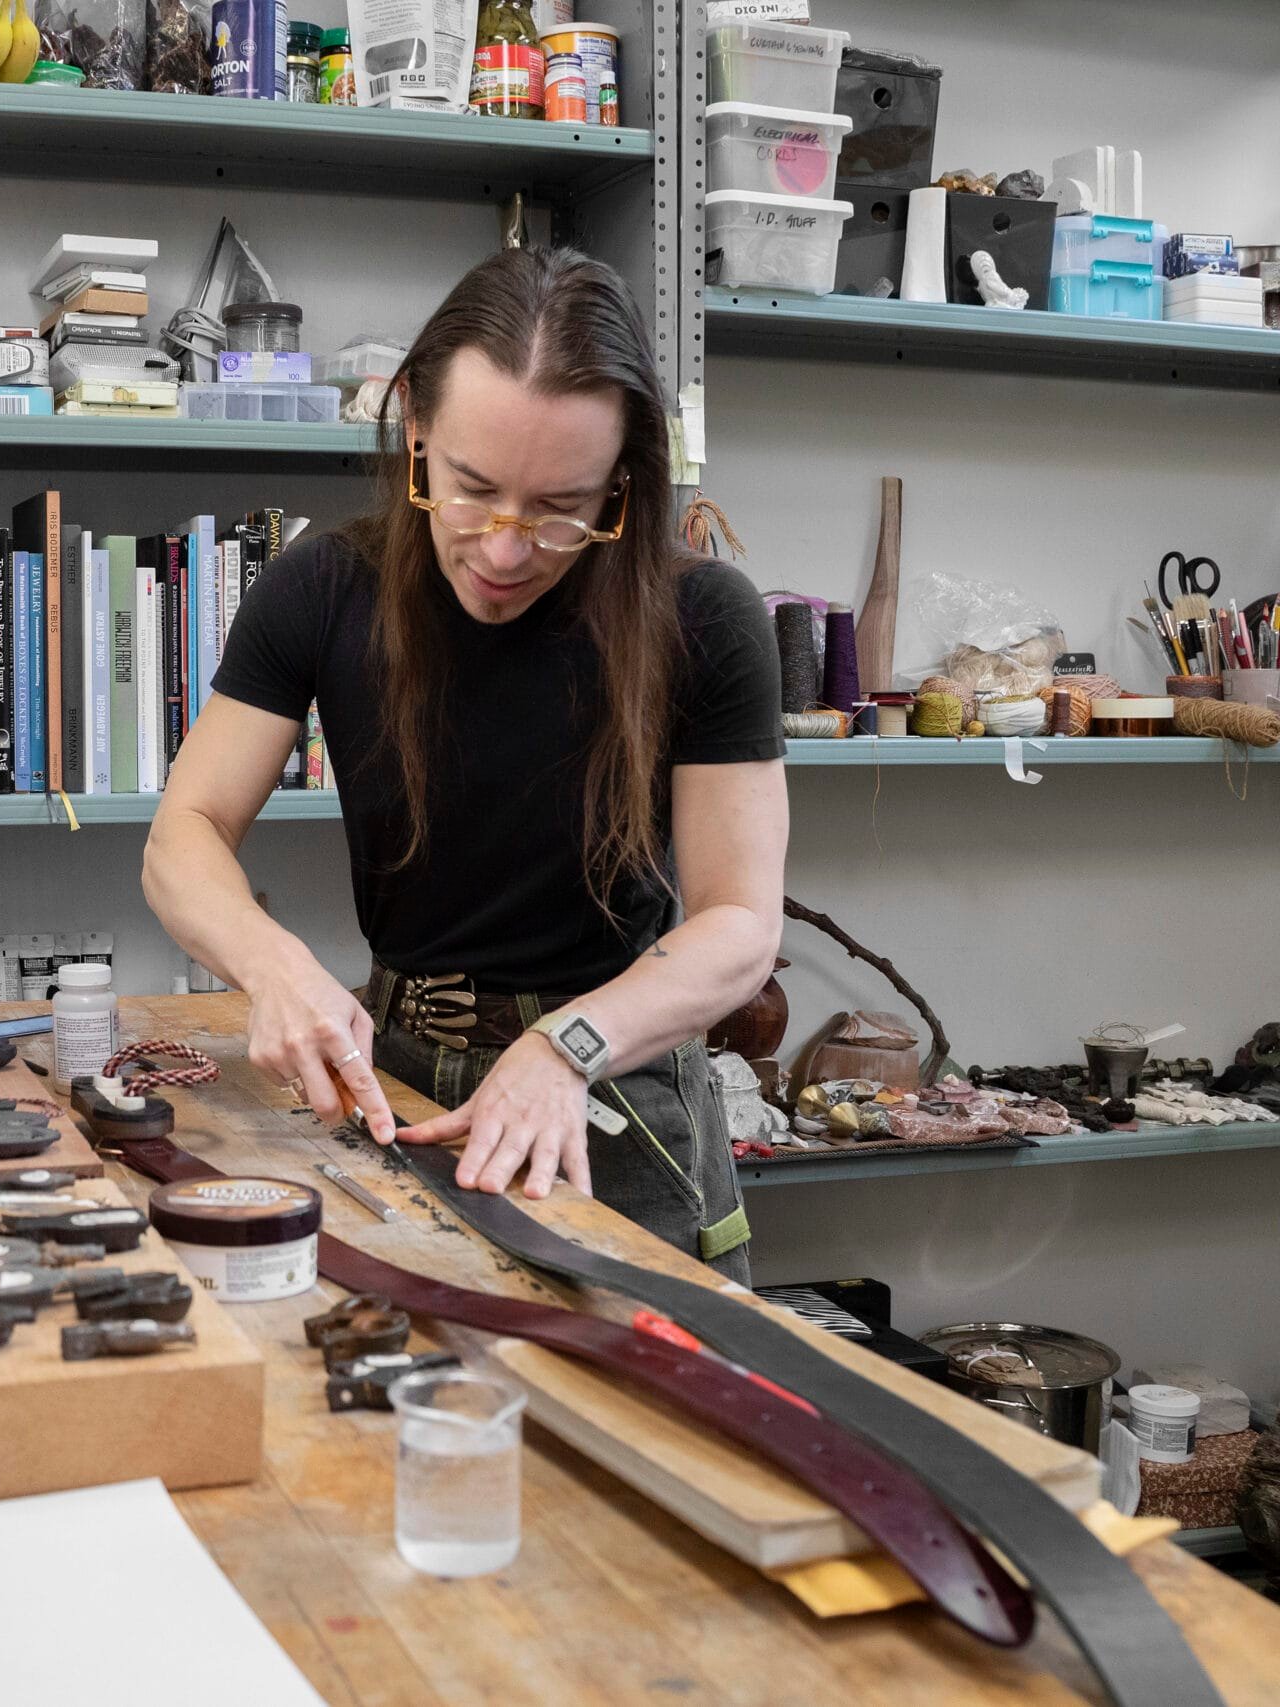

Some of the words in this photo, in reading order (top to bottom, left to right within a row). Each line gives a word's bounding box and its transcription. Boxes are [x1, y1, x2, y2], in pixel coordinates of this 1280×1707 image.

[734, 5, 757, 14] DIG
[761, 4, 778, 13] IN!
[214, 76, 232, 90] SALT
[474, 74, 498, 84] Cactus
[755, 211, 778, 226] I.D.
[786, 214, 817, 229] STUFF
[270, 513, 280, 548] DAWN
[50, 533, 58, 578] BODEMER
[68, 546, 76, 584] ESTHER
[170, 546, 179, 583] BRAIDS
[32, 564, 40, 614] JEWELRY
[204, 554, 214, 596] MARTIN
[96, 610, 105, 642] ASTRAY
[114, 610, 132, 648] WARWICK
[204, 599, 214, 646] PURYEAR
[96, 644, 105, 667] GONE
[114, 650, 132, 683] FREEMAN
[19, 676, 26, 686] &
[19, 686, 27, 734] LOCKETS
[96, 694, 106, 732] ABWEGEN
[68, 708, 77, 771] BRINKMANN
[96, 734, 106, 752] AUF
